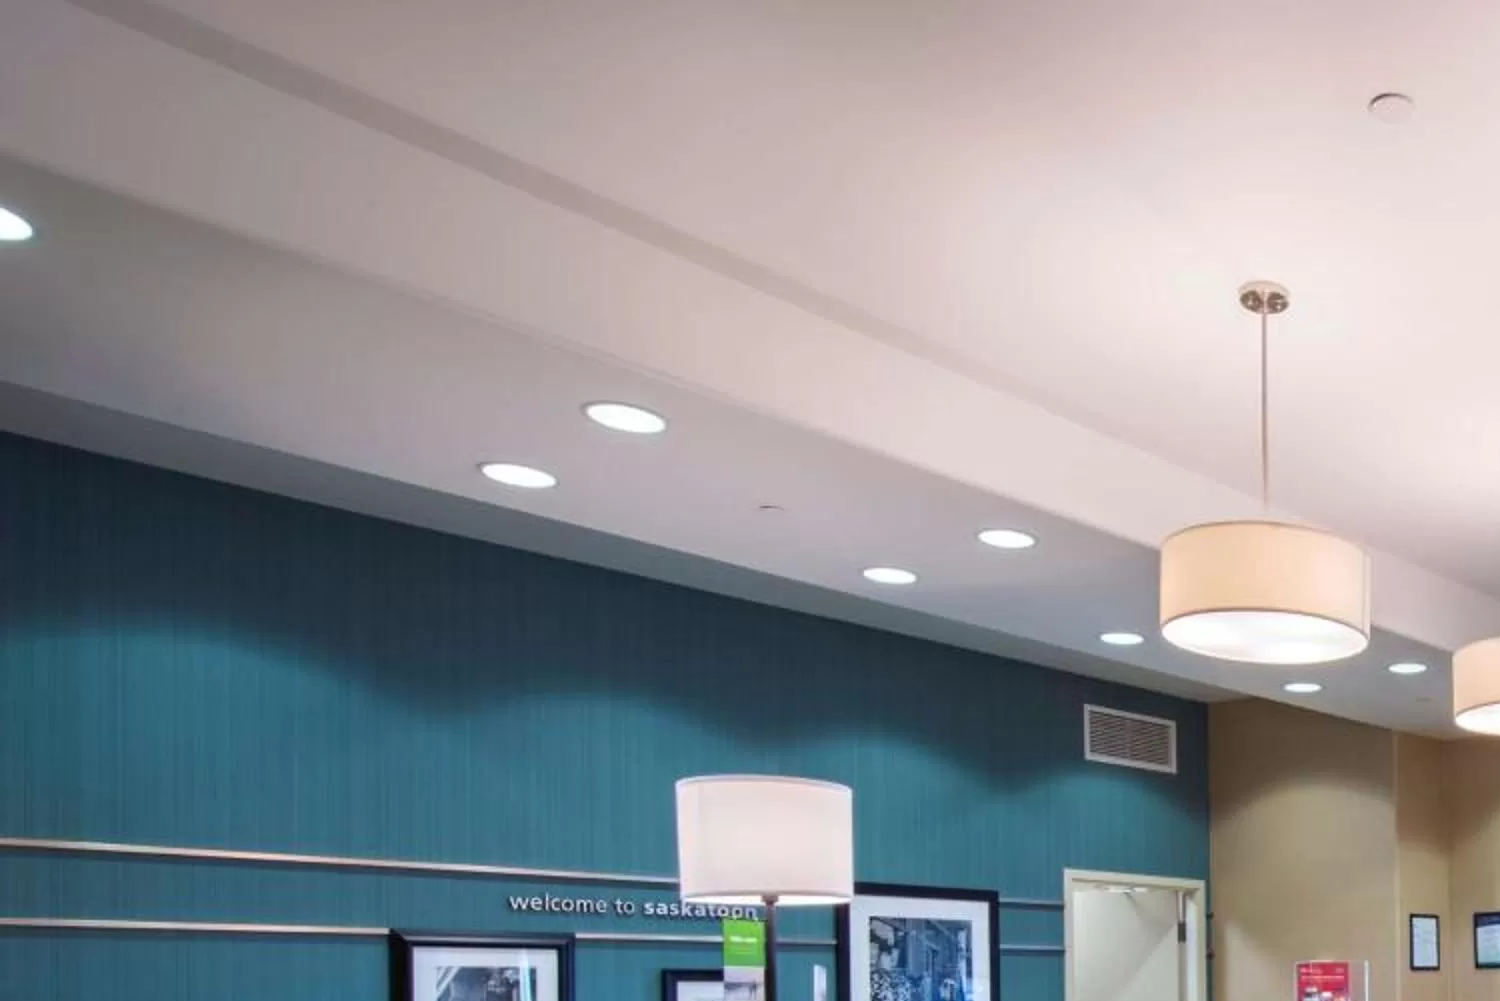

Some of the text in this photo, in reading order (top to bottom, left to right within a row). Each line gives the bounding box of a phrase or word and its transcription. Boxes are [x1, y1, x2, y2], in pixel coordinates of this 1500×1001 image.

[509, 892, 759, 920] welcome to saskatoon
